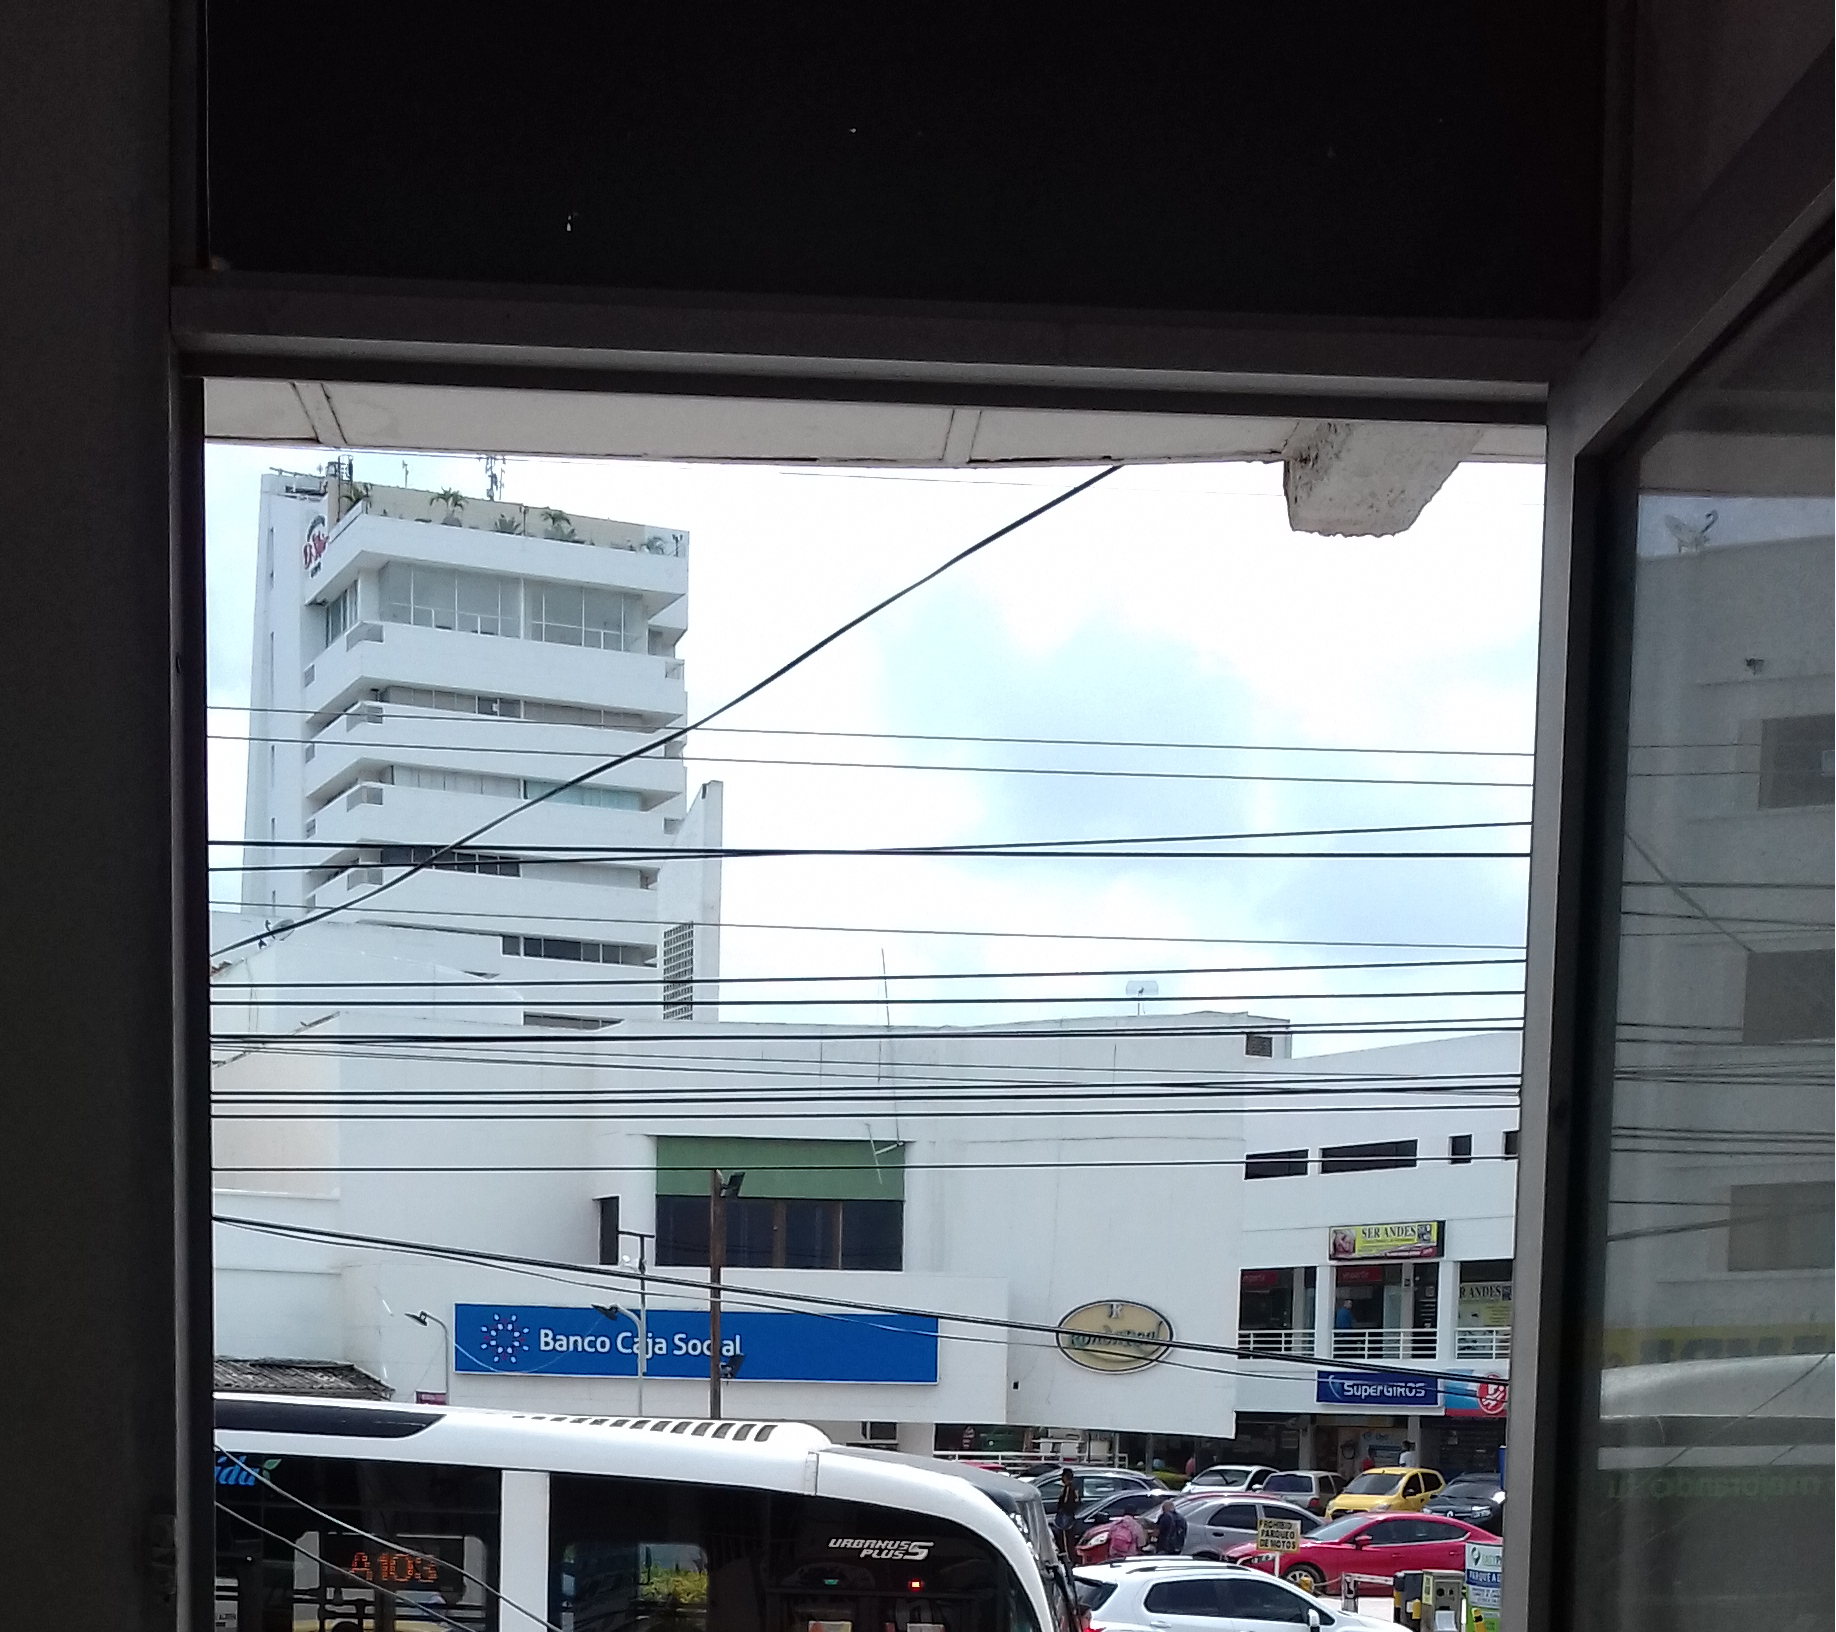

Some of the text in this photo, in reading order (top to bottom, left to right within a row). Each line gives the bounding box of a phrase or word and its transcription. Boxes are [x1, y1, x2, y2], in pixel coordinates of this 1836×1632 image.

[1362, 1225, 1416, 1239] SER ANDES
[539, 1328, 610, 1353] Banco
[672, 1333, 741, 1357] Socal
[351, 1552, 438, 1582] A103
